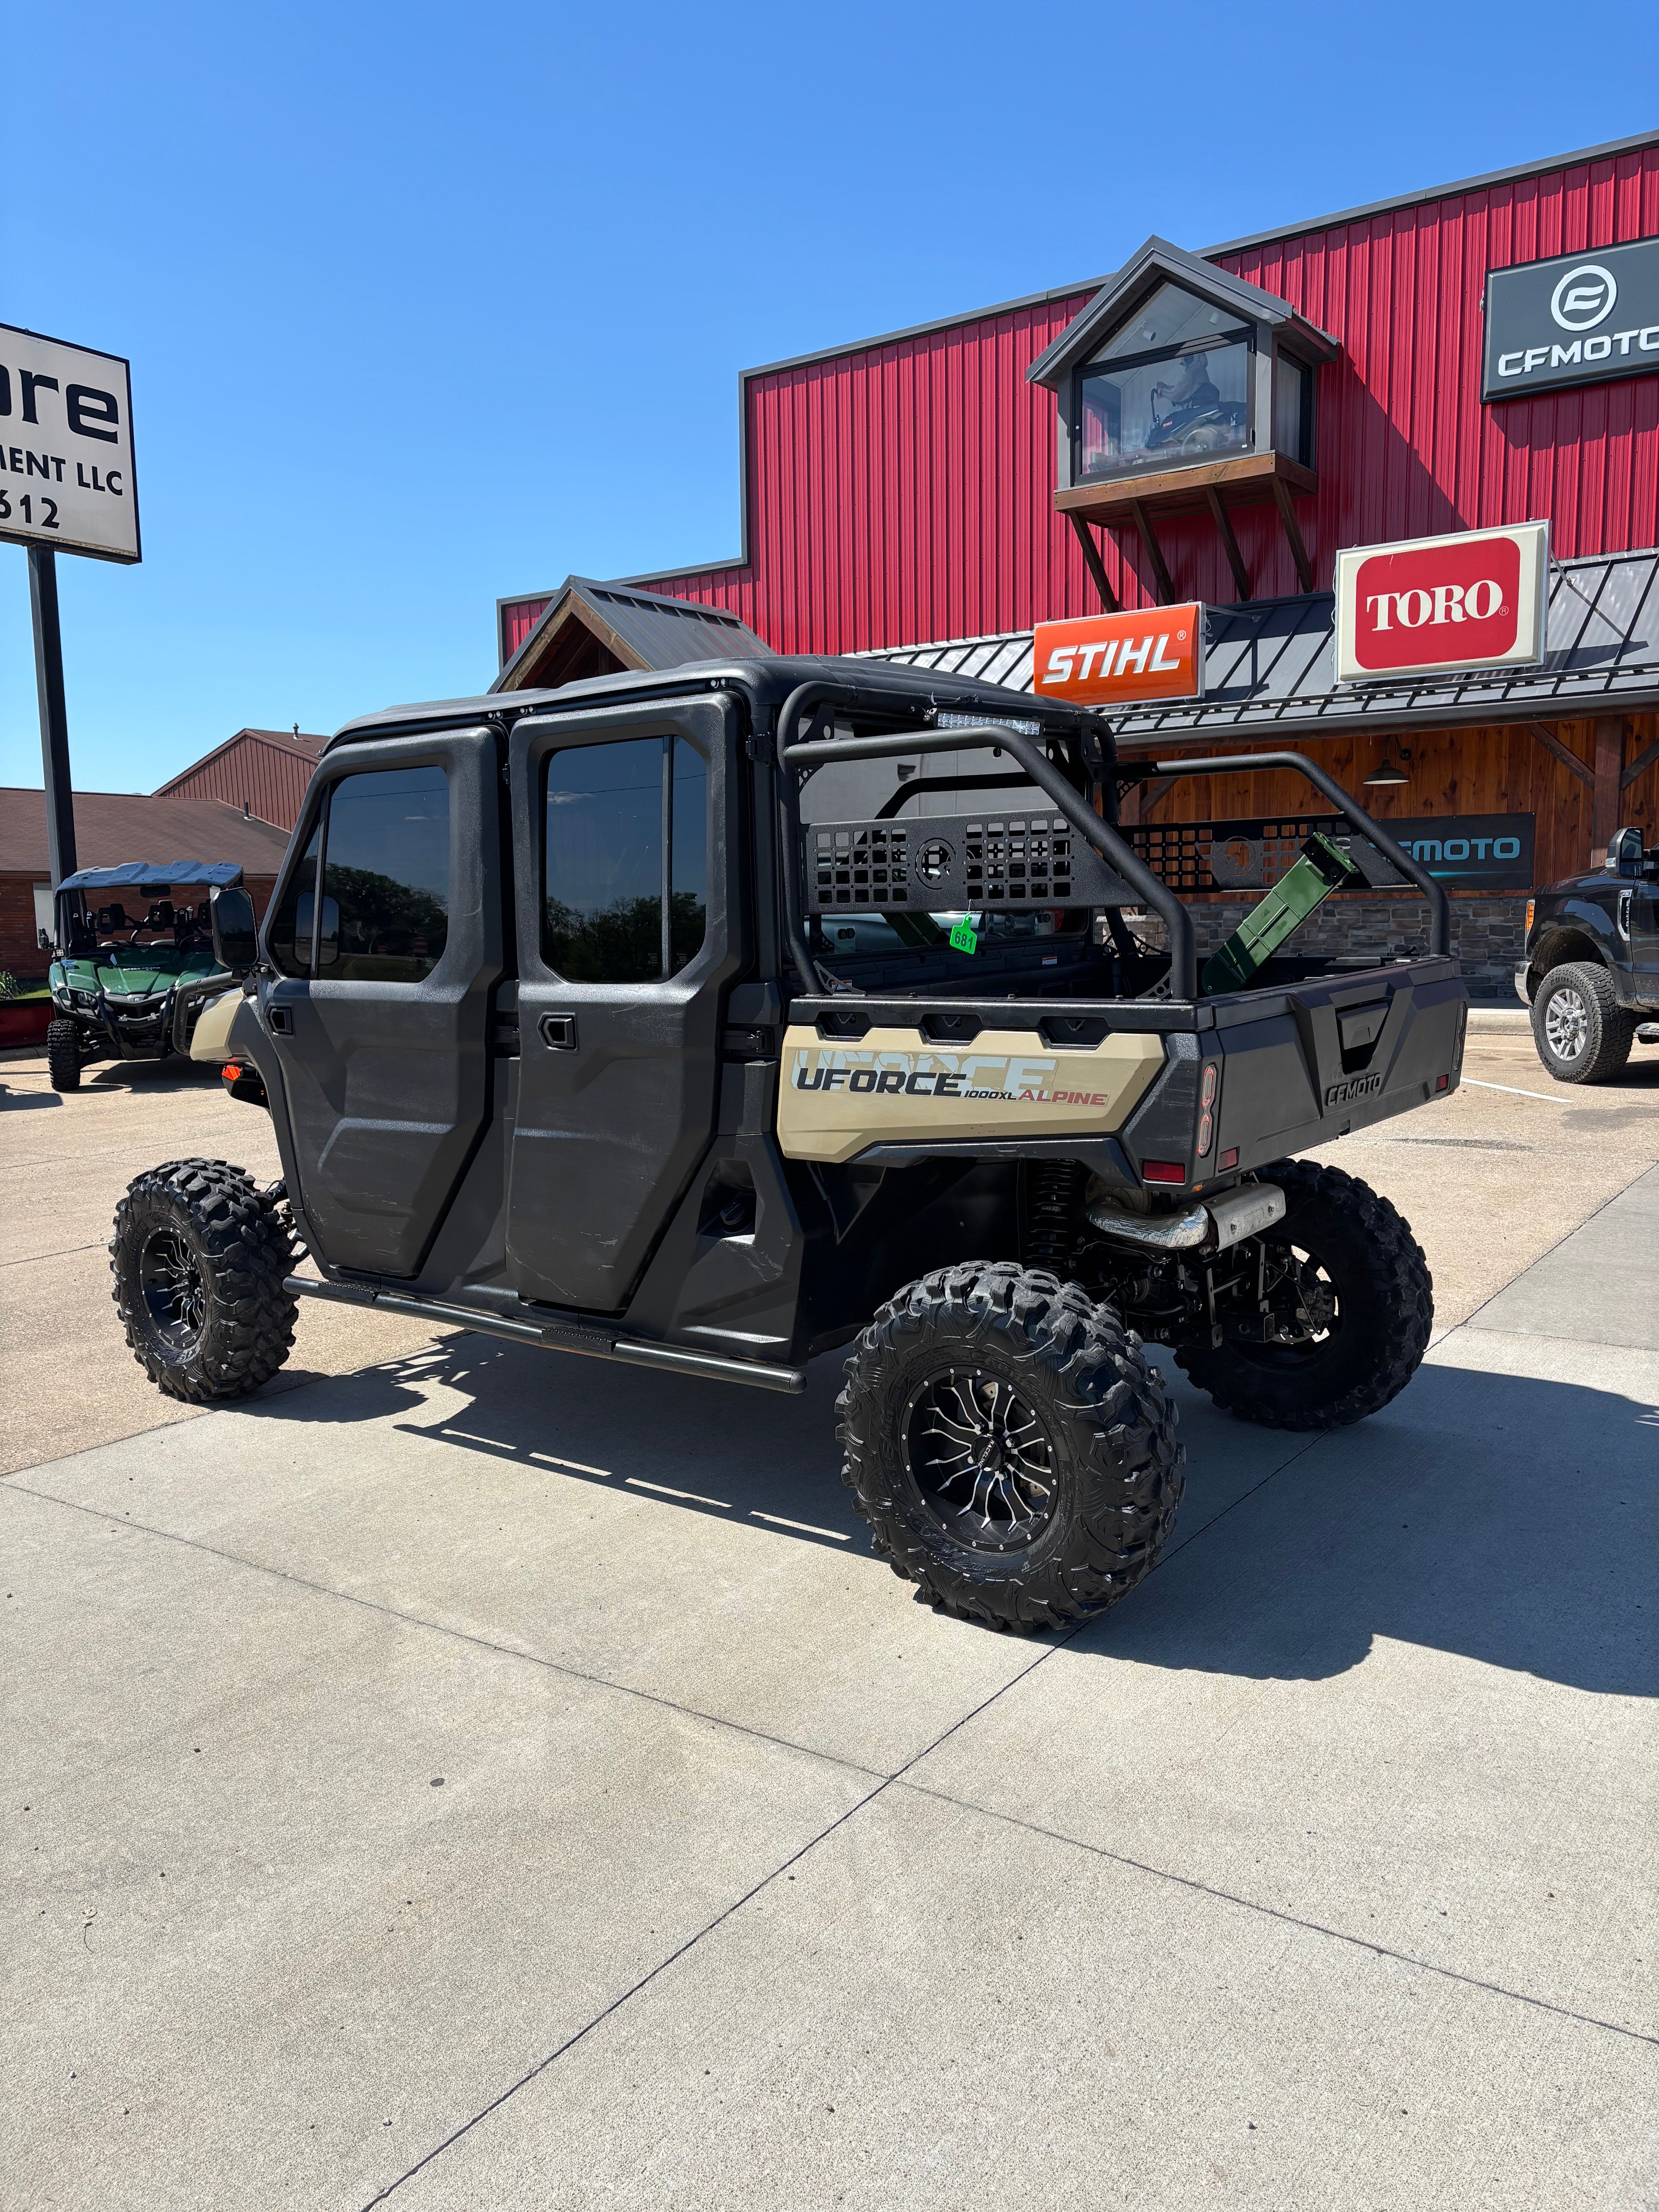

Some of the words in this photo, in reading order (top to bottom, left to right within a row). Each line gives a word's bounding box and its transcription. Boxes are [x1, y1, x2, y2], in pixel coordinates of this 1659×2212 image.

[1498, 326, 1659, 376] CFMOTO
[77, 462, 123, 496] LLC
[1366, 580, 1503, 631] TORO
[1041, 634, 1180, 684] STIHL
[955, 931, 973, 950] 681
[797, 1068, 967, 1097] UFORCE
[964, 1090, 1017, 1100] 1000XL
[1018, 1089, 1108, 1106] ALPINE
[1326, 1073, 1382, 1106] CFMOTO
[977, 1439, 994, 1468] RACELINE
